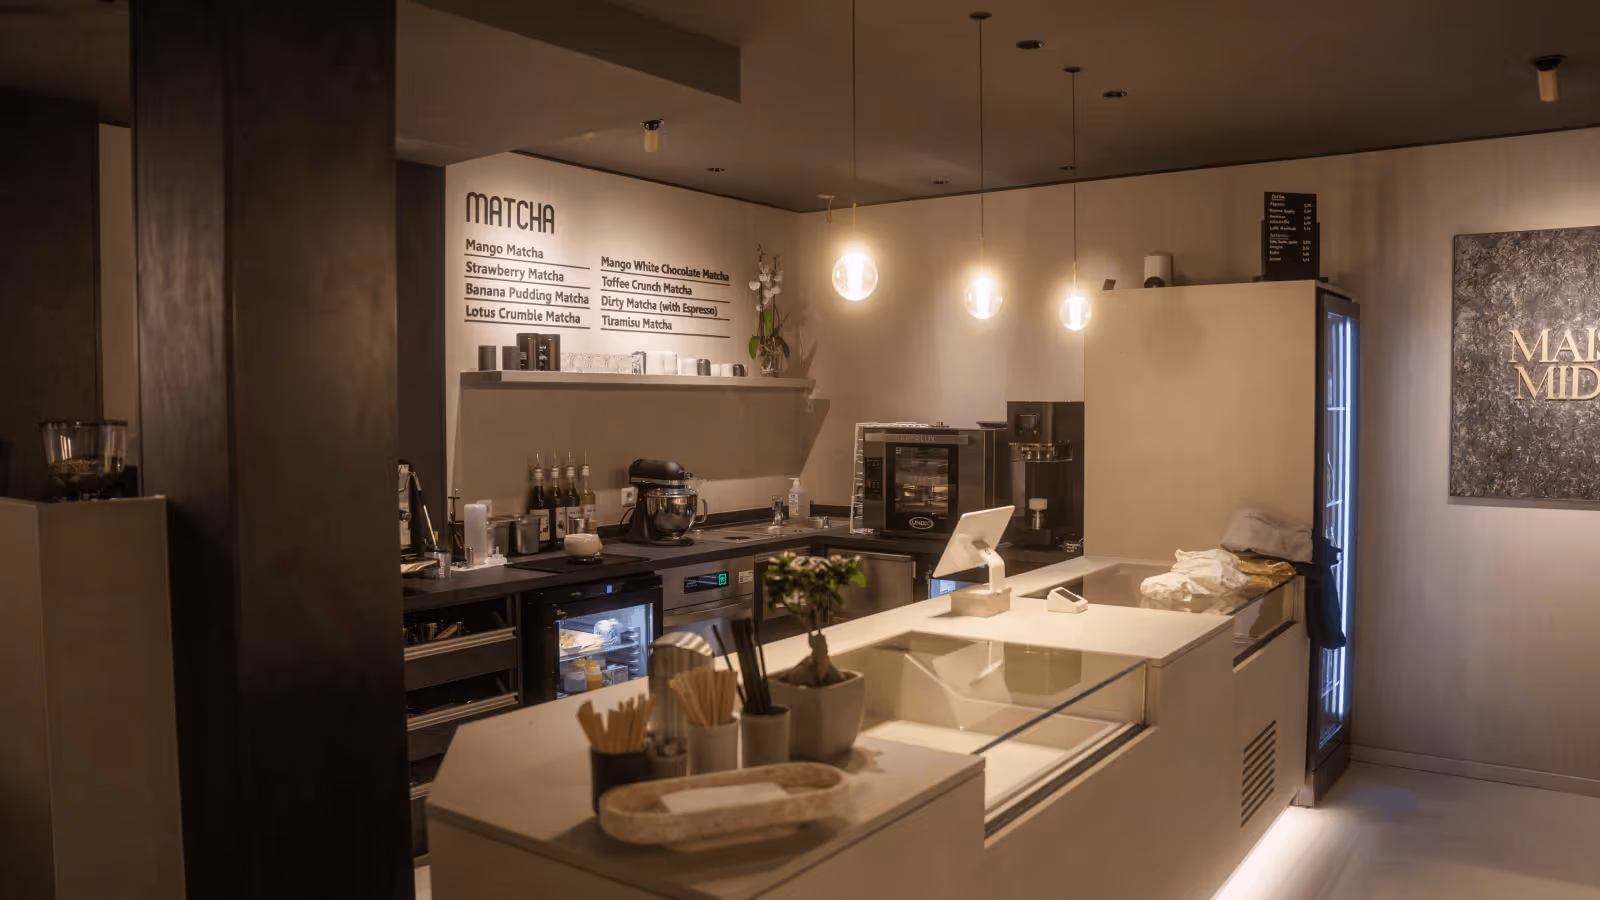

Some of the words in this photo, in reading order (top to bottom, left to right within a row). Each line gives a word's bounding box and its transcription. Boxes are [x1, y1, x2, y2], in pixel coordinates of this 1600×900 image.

[466, 191, 555, 234] MATCHA
[465, 239, 503, 256] Mango
[506, 244, 544, 259] Matcha
[465, 261, 526, 281] Strawberry
[528, 268, 565, 282] Matcha
[601, 256, 632, 271] Mango
[634, 260, 660, 273] White
[661, 264, 701, 278] Chocolate
[702, 268, 730, 281] Matcha
[465, 283, 506, 298] Banana
[509, 287, 552, 305] Pudding
[555, 291, 590, 304] Matcha
[601, 276, 630, 289] Toffee
[632, 280, 661, 292] Crunch
[663, 283, 693, 295] Matcha
[465, 305, 496, 319] Lotus
[498, 307, 543, 322] Crumble
[546, 311, 581, 324] Matcha
[601, 296, 625, 310] Dirty
[626, 298, 657, 310] Matcha
[659, 301, 681, 313] (with
[683, 303, 718, 317] Espresso)
[601, 315, 641, 328] Tiramisu
[642, 318, 673, 330] Matcha
[1508, 327, 1600, 363] MAI
[1514, 365, 1600, 400] MID
